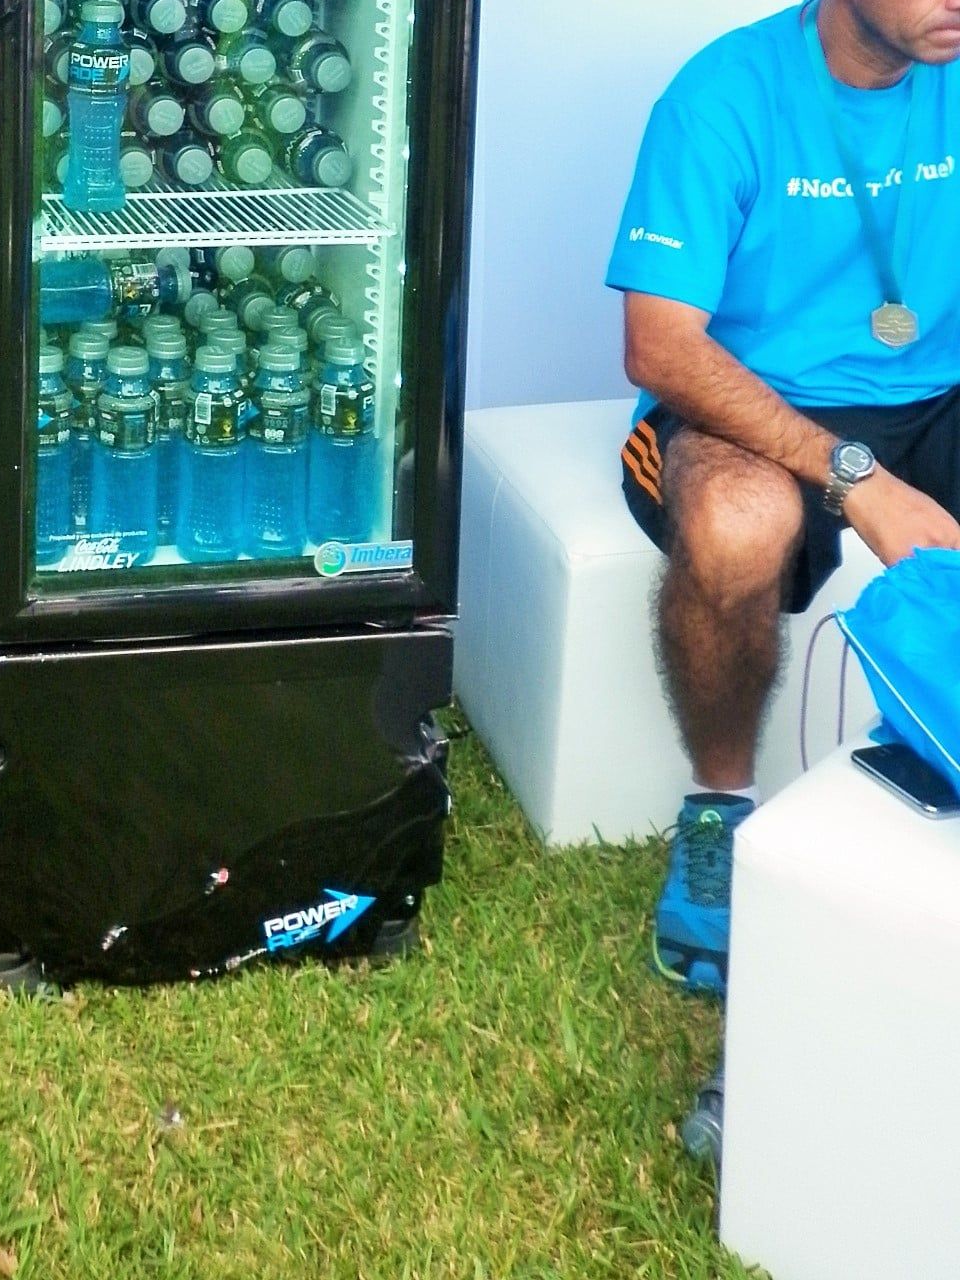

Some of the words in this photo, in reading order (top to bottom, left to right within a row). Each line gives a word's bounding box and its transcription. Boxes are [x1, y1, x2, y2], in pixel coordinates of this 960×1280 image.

[71, 52, 129, 69] POWER
[58, 552, 140, 572] LINDLEY
[351, 545, 412, 563] Imbera
[264, 894, 358, 937] POWER
